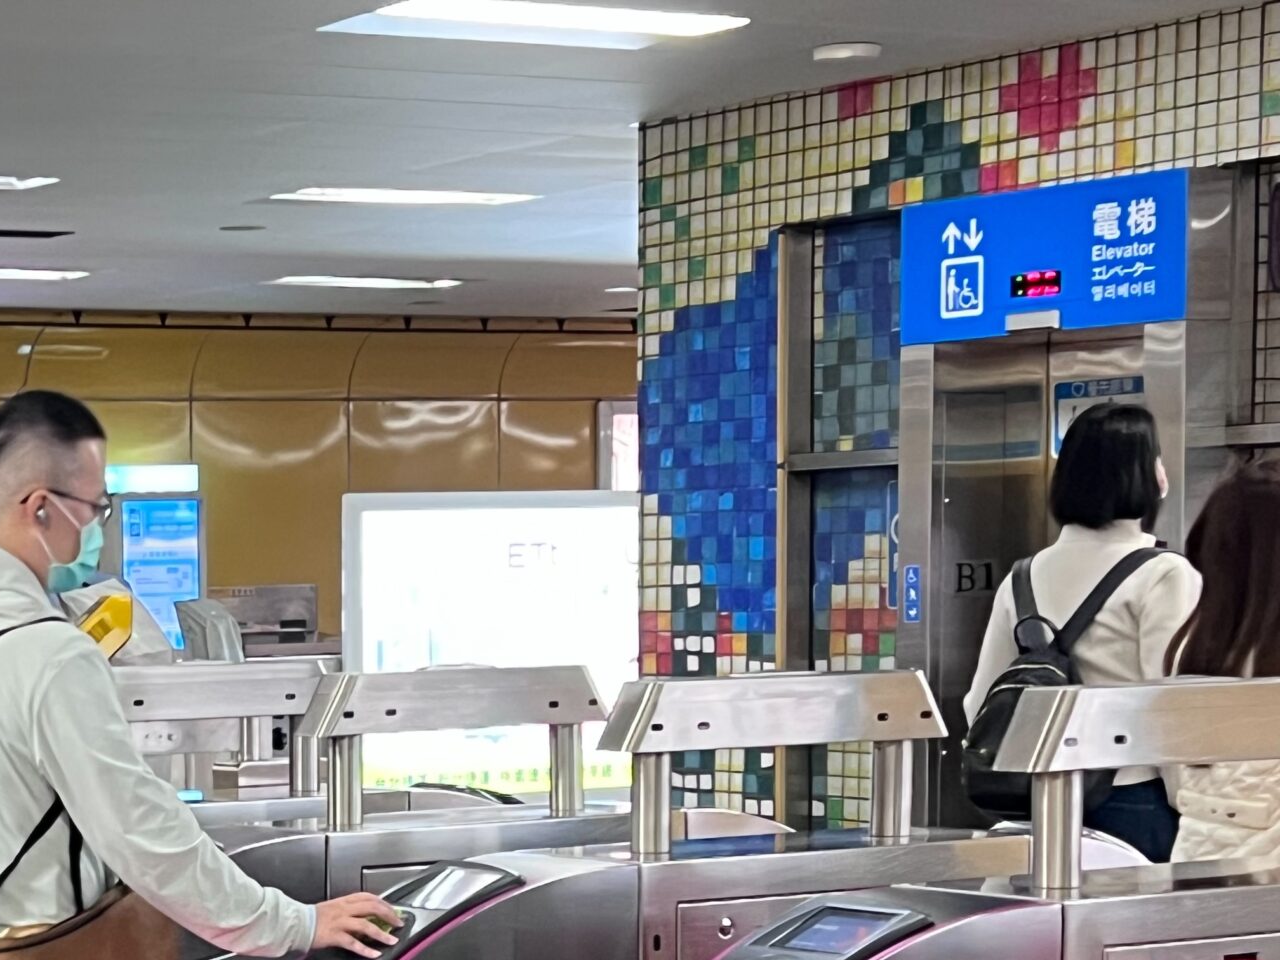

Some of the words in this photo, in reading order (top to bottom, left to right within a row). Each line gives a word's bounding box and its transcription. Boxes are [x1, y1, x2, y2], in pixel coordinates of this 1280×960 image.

[1092, 197, 1157, 240] 電梯
[1091, 242, 1156, 262] Elevator
[955, 561, 994, 593] B1
